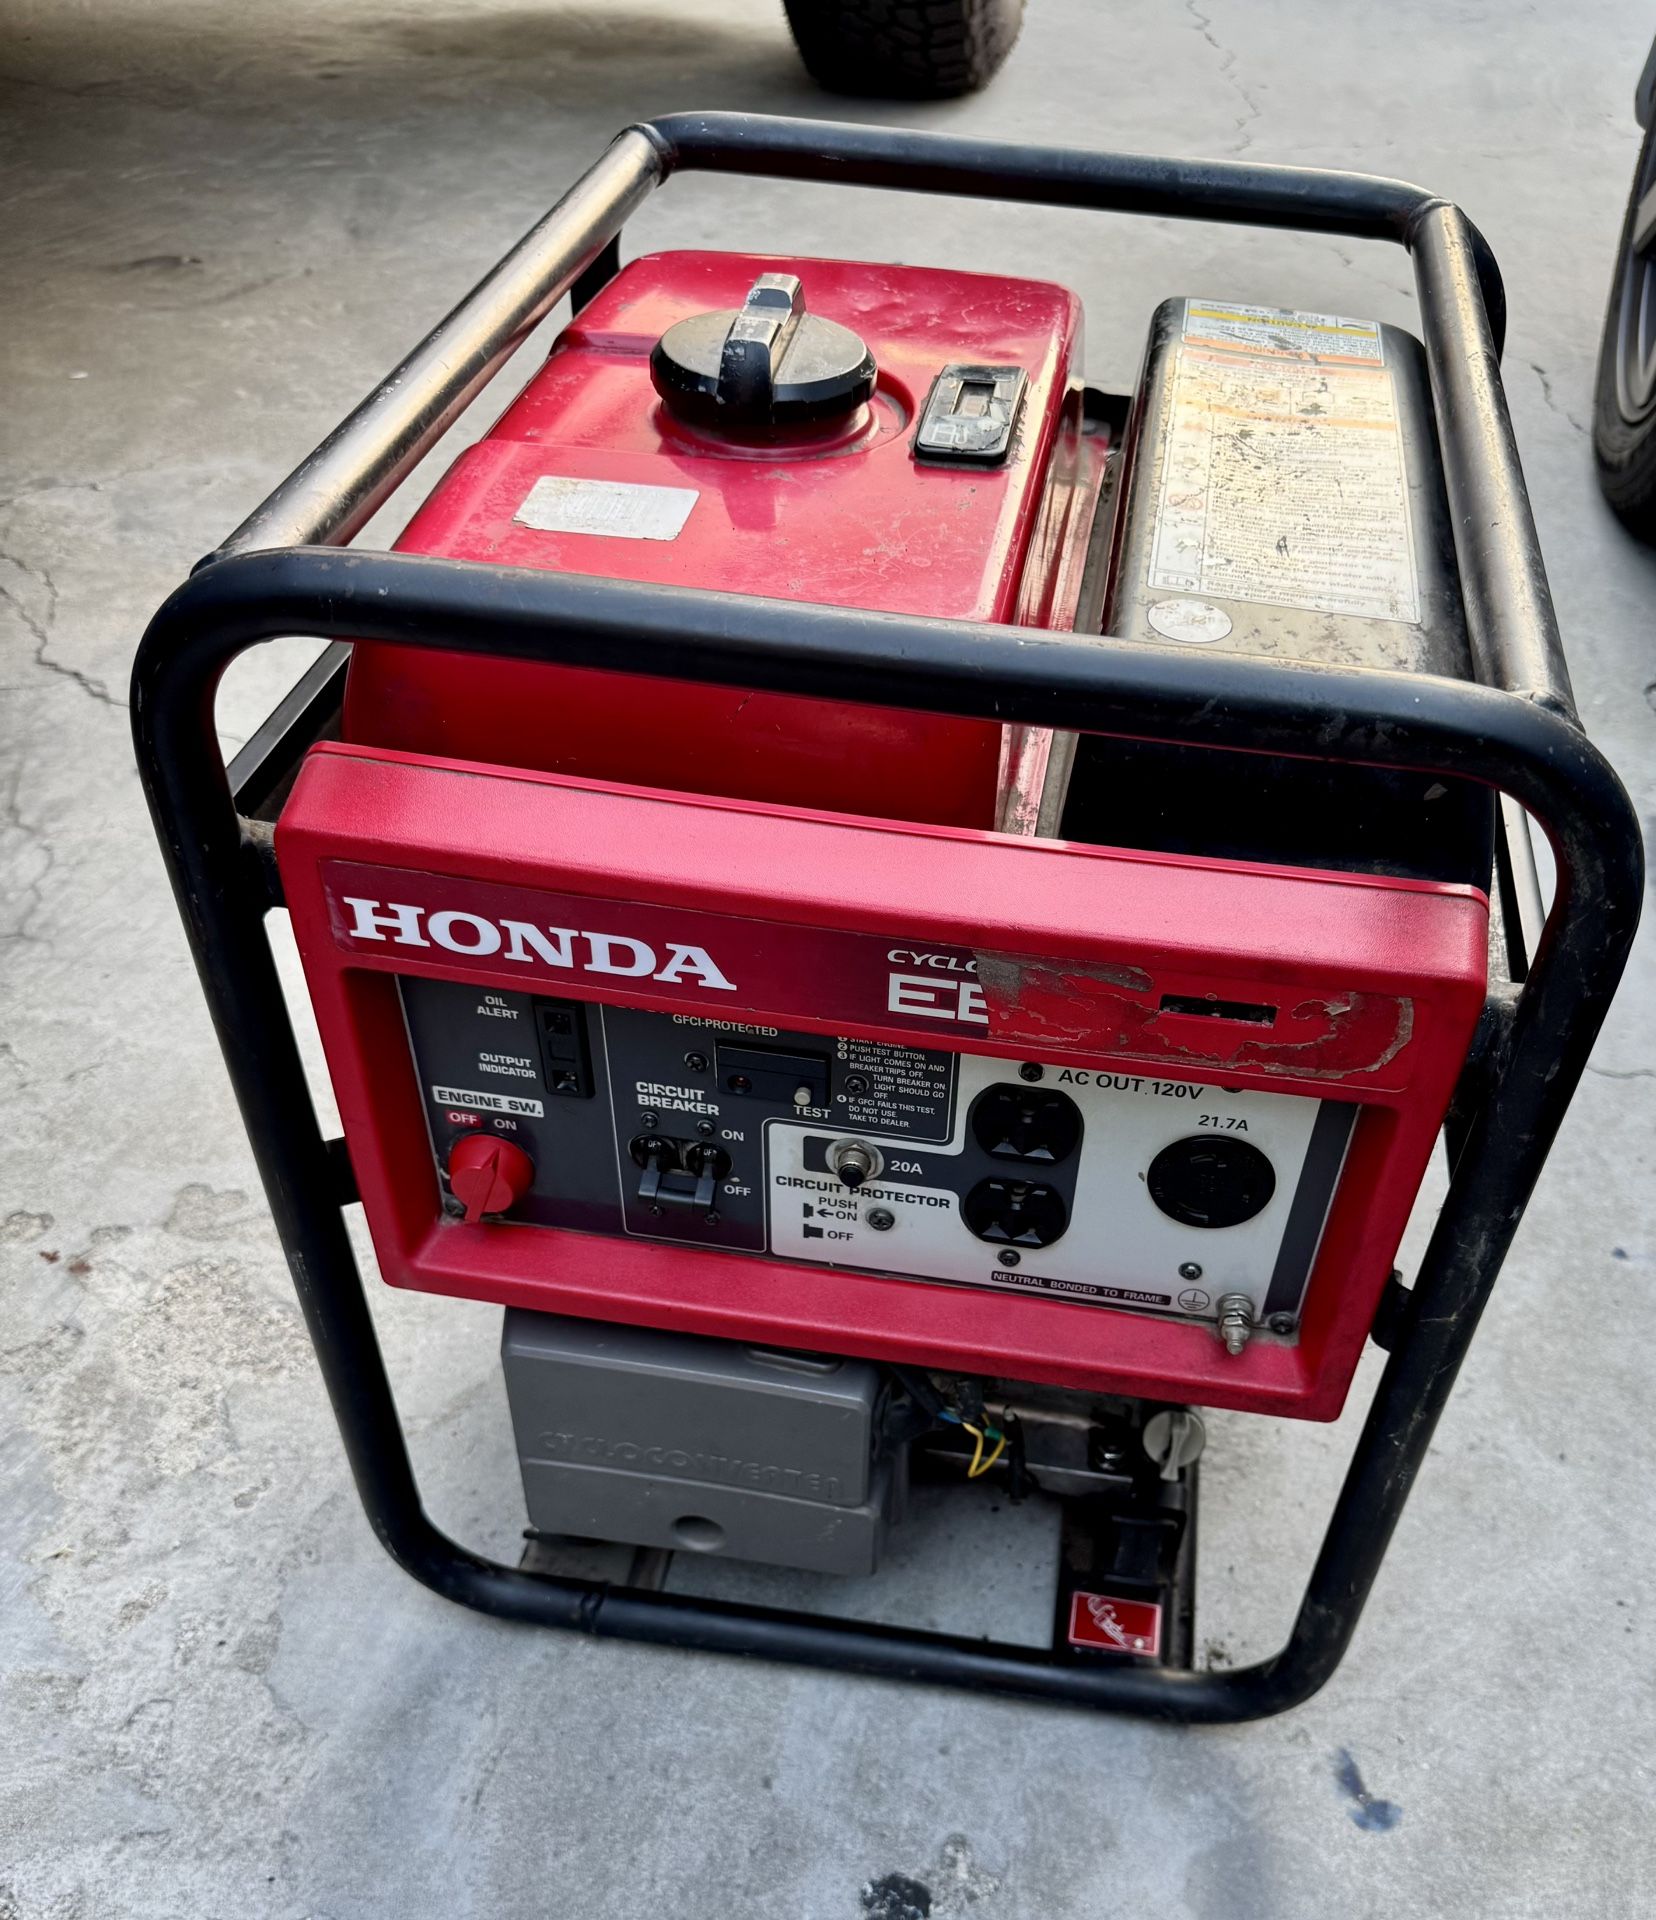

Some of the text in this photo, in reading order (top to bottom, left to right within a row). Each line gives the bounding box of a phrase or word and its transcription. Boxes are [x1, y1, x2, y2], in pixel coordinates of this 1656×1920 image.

[343, 897, 737, 991] HONDA
[485, 996, 508, 1008] OIL
[476, 1005, 519, 1020] ALERT
[673, 1013, 779, 1037] GFCI-PROTECTED
[850, 1045, 871, 1054] PUSH
[872, 1047, 891, 1056] TEST
[480, 1052, 533, 1067] OUTPUT
[859, 1055, 881, 1064] LIGHT
[884, 1058, 912, 1068] COMES
[914, 1062, 926, 1070] ON
[928, 1064, 945, 1072] AND
[478, 1062, 536, 1079] INDICATOR
[849, 1063, 884, 1073] BREAKER
[885, 1067, 906, 1076] TRIPS
[873, 1074, 894, 1083] TURN
[896, 1077, 931, 1088] BREAKER
[1058, 1069, 1089, 1086] AC
[1151, 1081, 1204, 1099] 120V
[636, 1081, 705, 1101] CIRCUIT
[874, 1083, 945, 1099] LIGHT SHOULD GO
[438, 1090, 542, 1116] ENGINE SW.
[637, 1095, 720, 1116] BREAKER
[848, 1105, 861, 1113] DO
[862, 1107, 879, 1115] NOT
[857, 1098, 875, 1106] GFCI
[877, 1101, 898, 1109] FAILS
[898, 1104, 915, 1112] THIS
[793, 1104, 832, 1119] TEST
[848, 1113, 867, 1122] TAKE
[449, 1112, 517, 1131] OFF ON
[1198, 1114, 1249, 1131] 21.7A
[721, 1129, 745, 1142] ON
[890, 1160, 923, 1175] 20A
[724, 1184, 752, 1197] OFF
[776, 1175, 952, 1209] CIRCUIT PROTECTOR
[819, 1196, 858, 1210] PUSH
[836, 1210, 858, 1221] ON
[828, 1230, 854, 1241] OFF
[994, 1272, 1044, 1287] NEUTRAL
[1050, 1280, 1097, 1294] BONDED
[1103, 1288, 1119, 1297] TO
